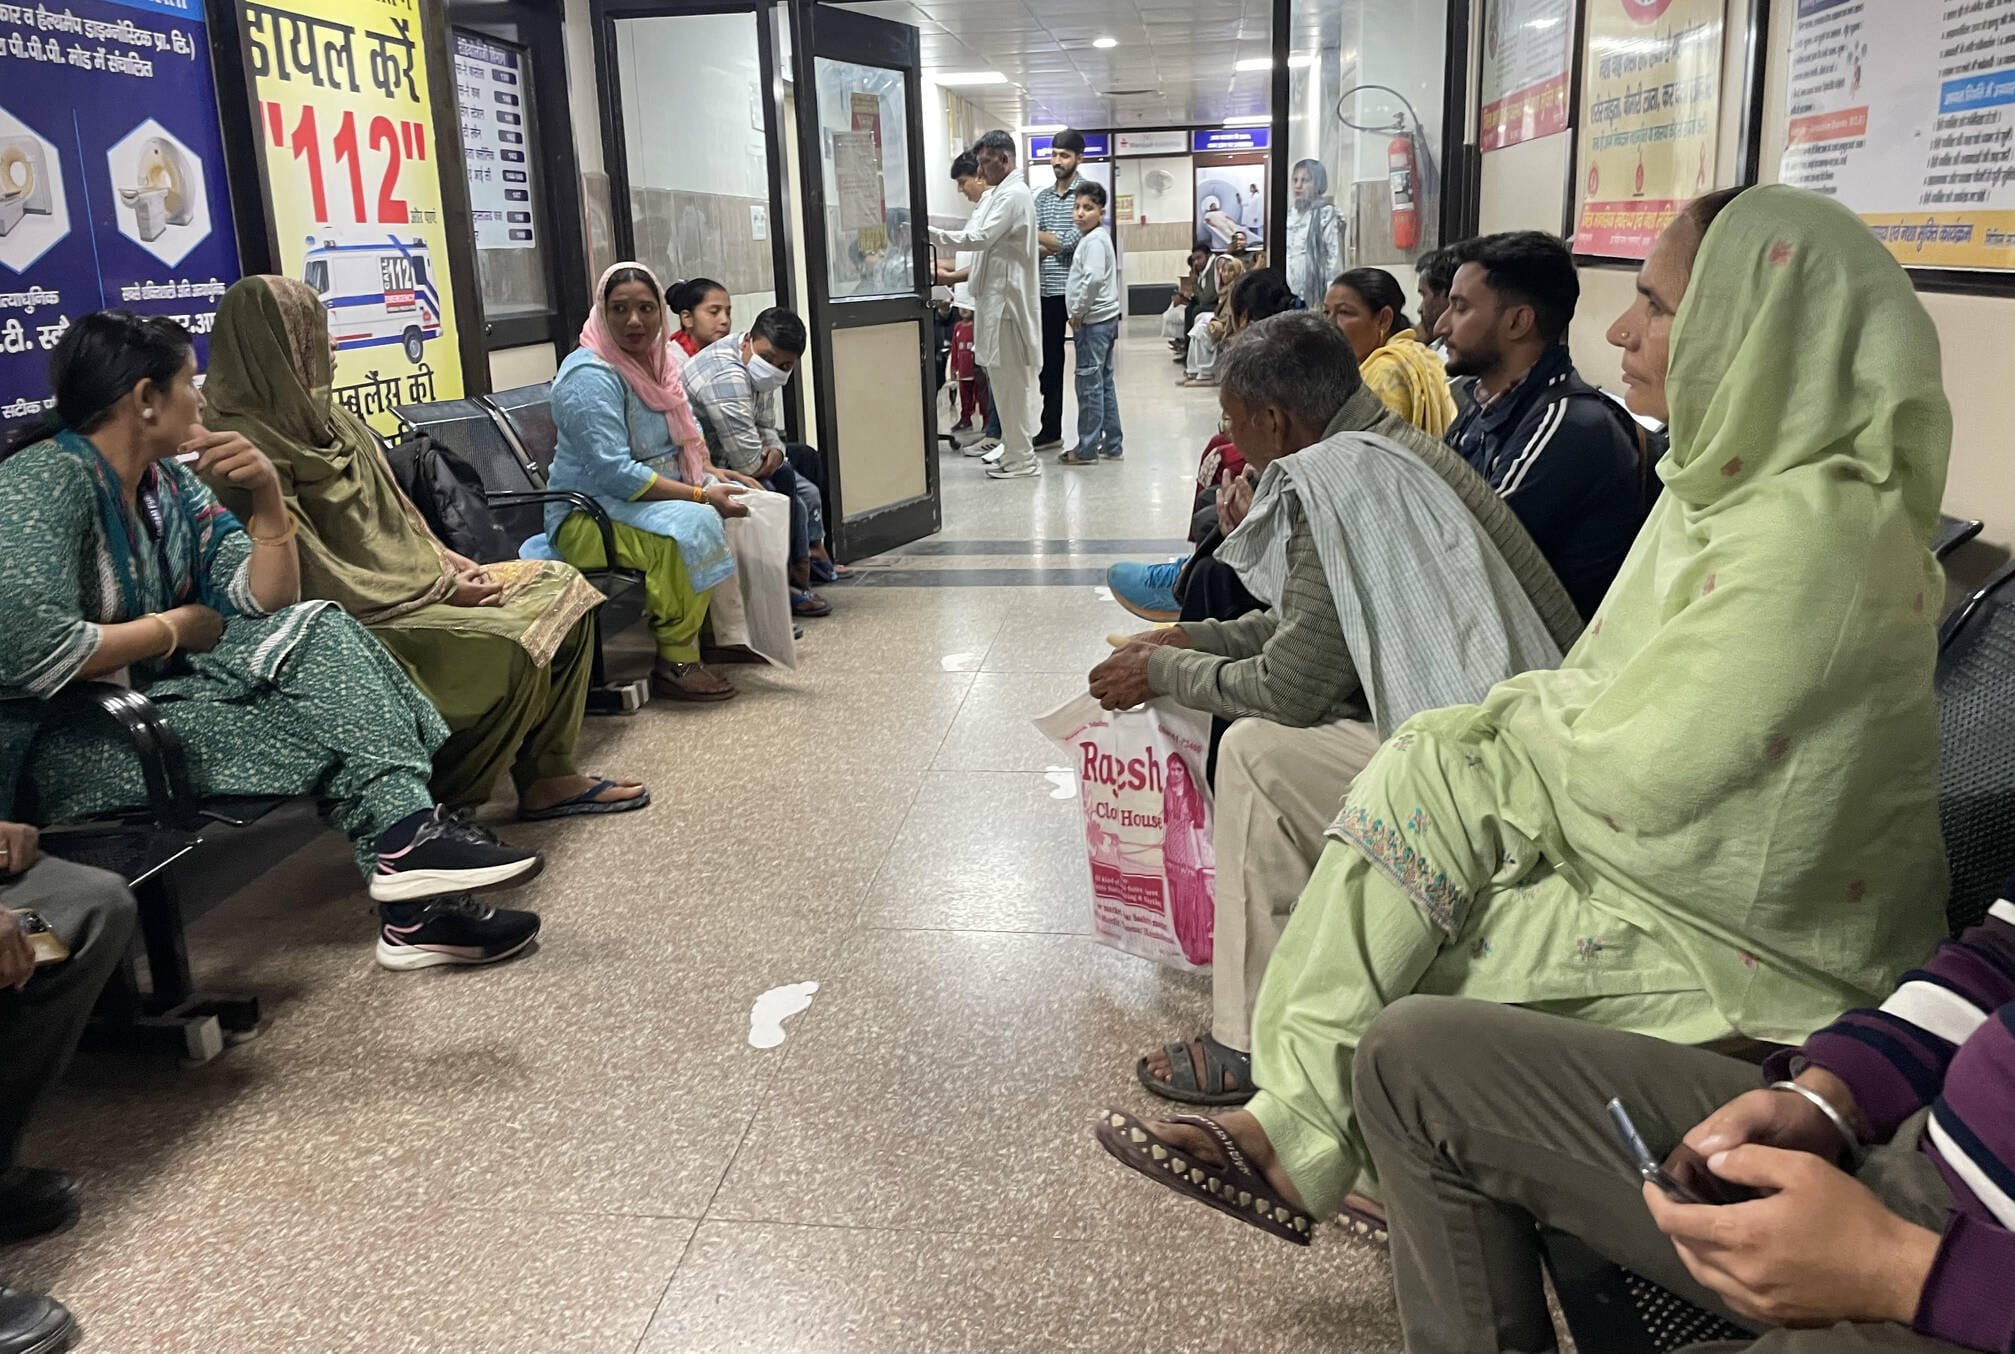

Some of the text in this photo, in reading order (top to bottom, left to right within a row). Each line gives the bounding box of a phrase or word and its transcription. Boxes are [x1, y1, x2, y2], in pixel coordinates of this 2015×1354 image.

[23, 10, 34, 26] व
[244, 4, 420, 103] डायल करें
[388, 257, 413, 290] 112
[406, 362, 437, 404] की
